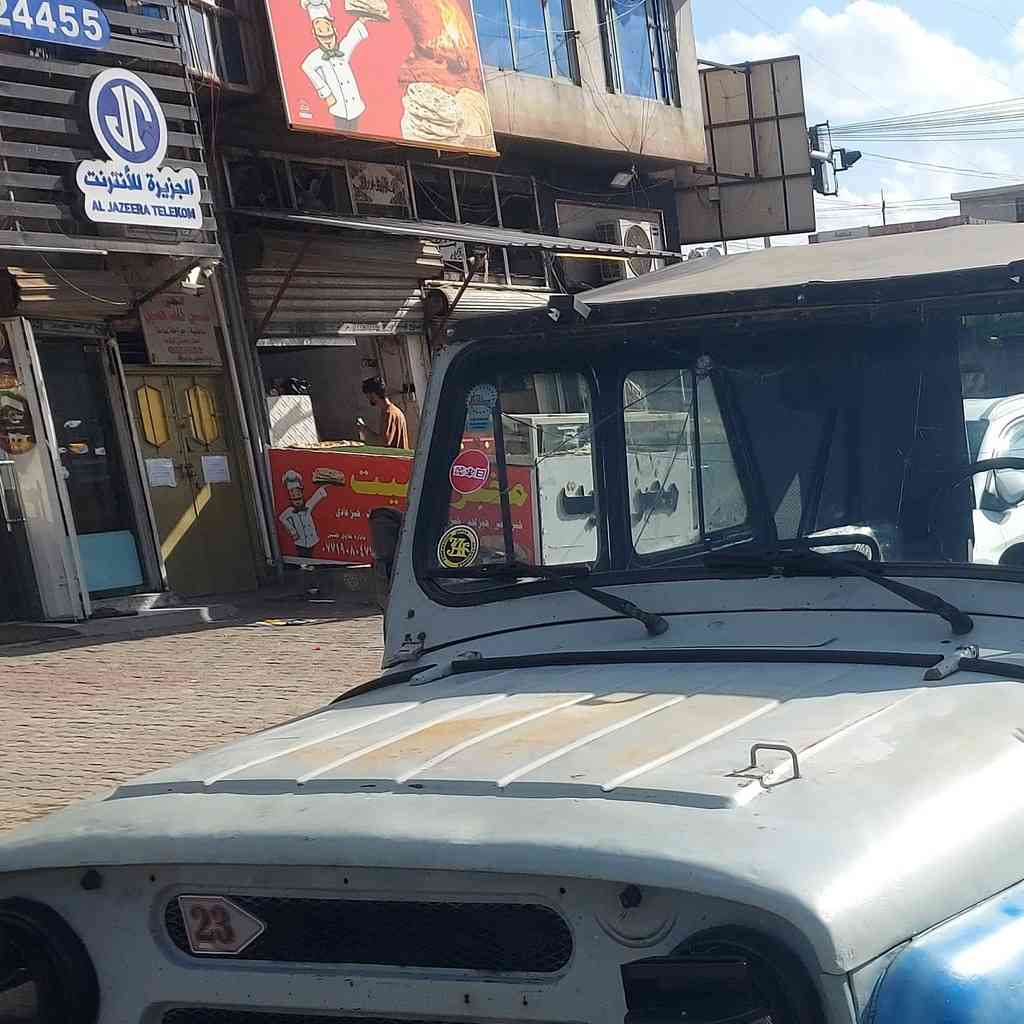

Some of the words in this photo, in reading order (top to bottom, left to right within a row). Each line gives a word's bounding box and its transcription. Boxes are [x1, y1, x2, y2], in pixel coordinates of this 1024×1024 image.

[146, 172, 194, 201] الجزيرة
[92, 199, 106, 212] AL
[107, 201, 151, 216] JAZEERA
[151, 204, 196, 220] TELEKOM
